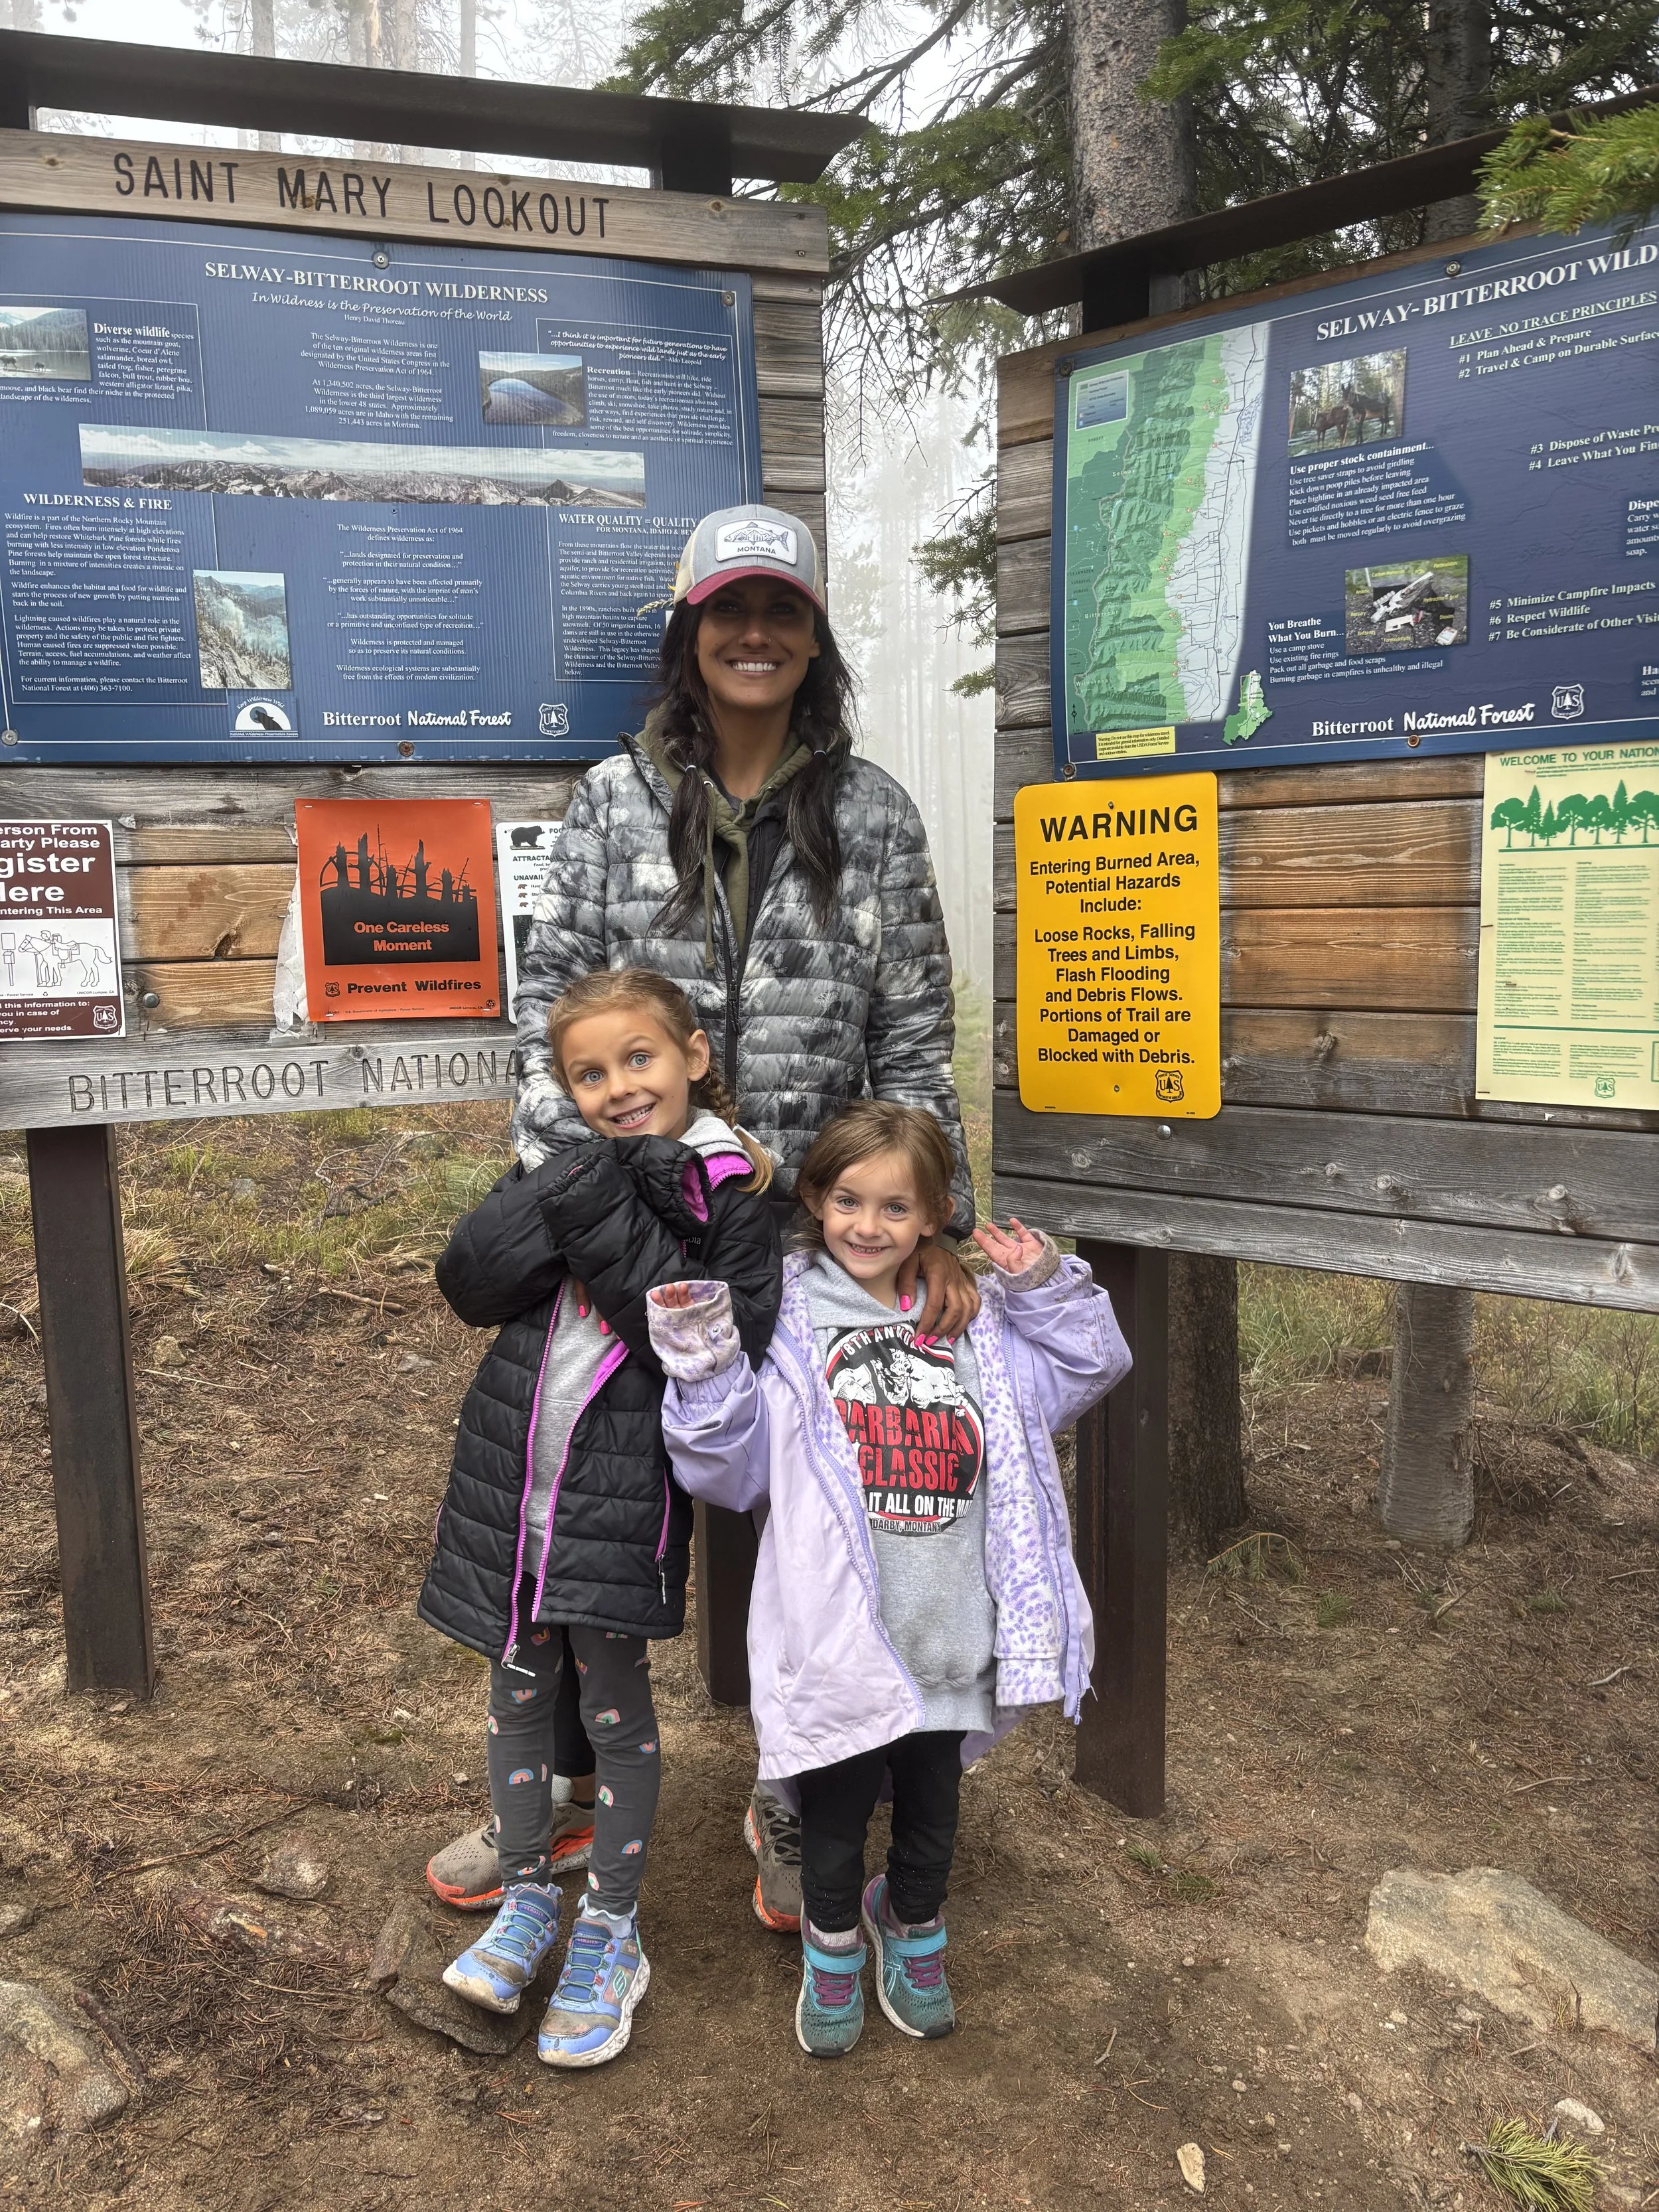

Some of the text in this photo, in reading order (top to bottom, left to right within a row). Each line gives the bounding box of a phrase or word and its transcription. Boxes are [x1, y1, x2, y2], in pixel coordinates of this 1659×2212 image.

[113, 152, 610, 238] SAINT MARY LOOKOUT
[206, 262, 547, 303] SELWAY-BITTERROOT WILDERNESS
[1317, 245, 1658, 340] SELWAY-BITTERROOT WILD
[252, 292, 512, 321] In Wildness is the Preservation of the World
[344, 314, 361, 323] Henry
[1449, 291, 1657, 346] LEAVE NO TRACE PRINCIPLES
[94, 323, 171, 338] Diverse wildlife
[1459, 330, 1592, 364] #1 Plan Ahead & Prepare
[1459, 368, 1470, 379] #2
[1476, 360, 1508, 375] Travel
[1510, 358, 1520, 368] &
[1524, 353, 1555, 364] Camp
[1575, 338, 1618, 354] Durable
[1531, 443, 1543, 454] #3
[1550, 437, 1590, 451] Dispose
[1593, 432, 1605, 443] of
[1607, 429, 1640, 440] Waste
[1291, 466, 1306, 475] Use
[1308, 460, 1339, 474] proper
[1341, 453, 1365, 465] stock
[1529, 460, 1541, 471] #4
[1548, 456, 1579, 467] Leave
[1582, 449, 1613, 461] What
[1615, 445, 1635, 455] You
[23, 494, 172, 510] WILDERNESS & FIRE
[559, 514, 595, 524] WATER
[597, 515, 642, 526] QUALITY
[653, 517, 696, 528] QUALITY
[737, 546, 776, 555] MONTANA
[1489, 581, 1656, 609] #5 Minimize Campfire Impacts
[1268, 618, 1321, 630] You Breathe
[1489, 605, 1591, 625] #6 Respect Wildlife
[1268, 634, 1292, 642] What
[1488, 631, 1500, 641] #7
[1506, 630, 1520, 639] Be
[1522, 623, 1584, 636] Considerate
[1587, 620, 1599, 629] of
[1601, 617, 1634, 628] Other
[323, 709, 512, 726] Bitterroot National Forest
[1312, 703, 1535, 736] Bitterroot National Forest
[1500, 754, 1556, 766] WELCOME
[1561, 753, 1577, 762] TO
[1583, 750, 1614, 761] YOUR
[0, 824, 98, 835] rson From
[1040, 804, 1196, 842] WARNING
[0, 838, 100, 851] arty Please
[0, 853, 96, 879] gister
[1031, 853, 1199, 875] Entering Burned Area,
[1046, 873, 1181, 895] Potential Hazards
[0, 907, 42, 916] ntering
[1080, 897, 1141, 913] Include:
[354, 921, 450, 933] One Careless
[1035, 923, 1194, 942] Loose Rocks, Falling
[373, 939, 432, 952] Moment
[1048, 945, 1179, 962] Trees and Limbs,
[1056, 966, 1169, 984] Flash Flooding
[347, 979, 482, 994] Prevent Wildfires
[1046, 987, 1183, 1002] and Debris Flows.
[1041, 1007, 1190, 1022] Portions of Trail are
[1068, 1029, 1160, 1045] Damaged or
[1039, 1048, 1194, 1063] Blocked with Debris.
[68, 1060, 329, 1113] BITTERROOT
[834, 1398, 974, 1455] ARBARIN
[859, 1445, 960, 1492] CLASSIC
[869, 1492, 882, 1512] IT
[885, 1493, 910, 1514] ALL
[914, 1495, 934, 1516] ON
[937, 1497, 955, 1518] THE
[904, 1520, 942, 1534] MONTANA
